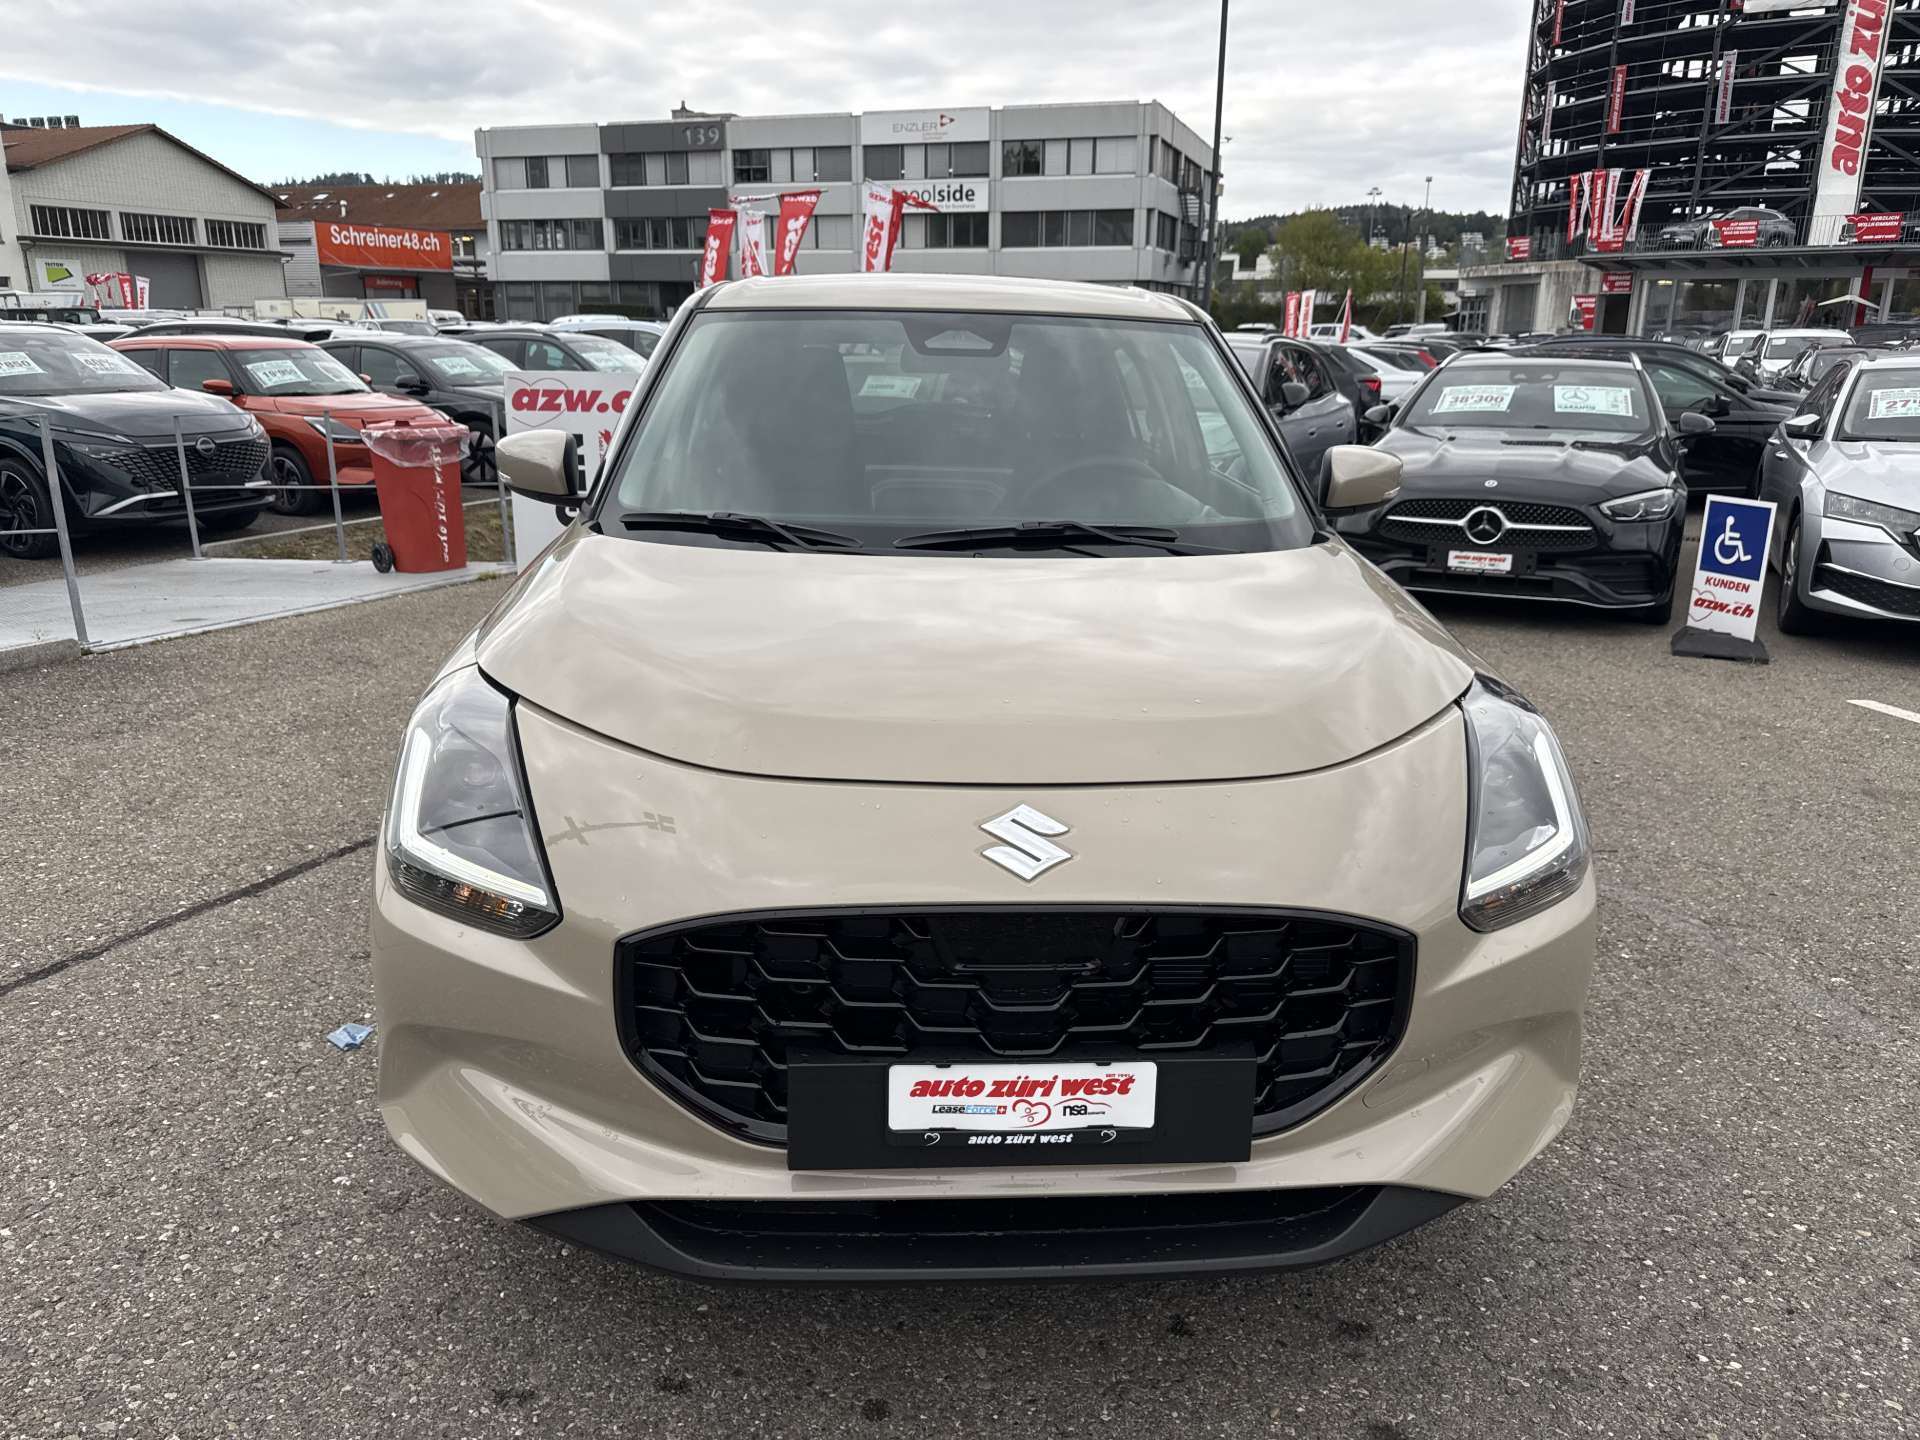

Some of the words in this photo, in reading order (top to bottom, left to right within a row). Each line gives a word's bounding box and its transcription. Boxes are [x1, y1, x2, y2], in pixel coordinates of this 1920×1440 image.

[892, 122, 938, 133] ENZLER
[1832, 64, 1873, 176] auto
[684, 127, 719, 145] 139
[330, 224, 440, 251] Schreiner48.ch
[1705, 576, 1750, 593] KUNDEN
[1694, 597, 1754, 618] azw.ch
[909, 1076, 985, 1097] auto
[986, 1075, 1059, 1097] züri
[1061, 1075, 1135, 1096] west
[1063, 1105, 1087, 1116] nsa
[968, 1134, 1002, 1145] auto
[1005, 1132, 1036, 1144] züri
[1039, 1132, 1073, 1144] west
